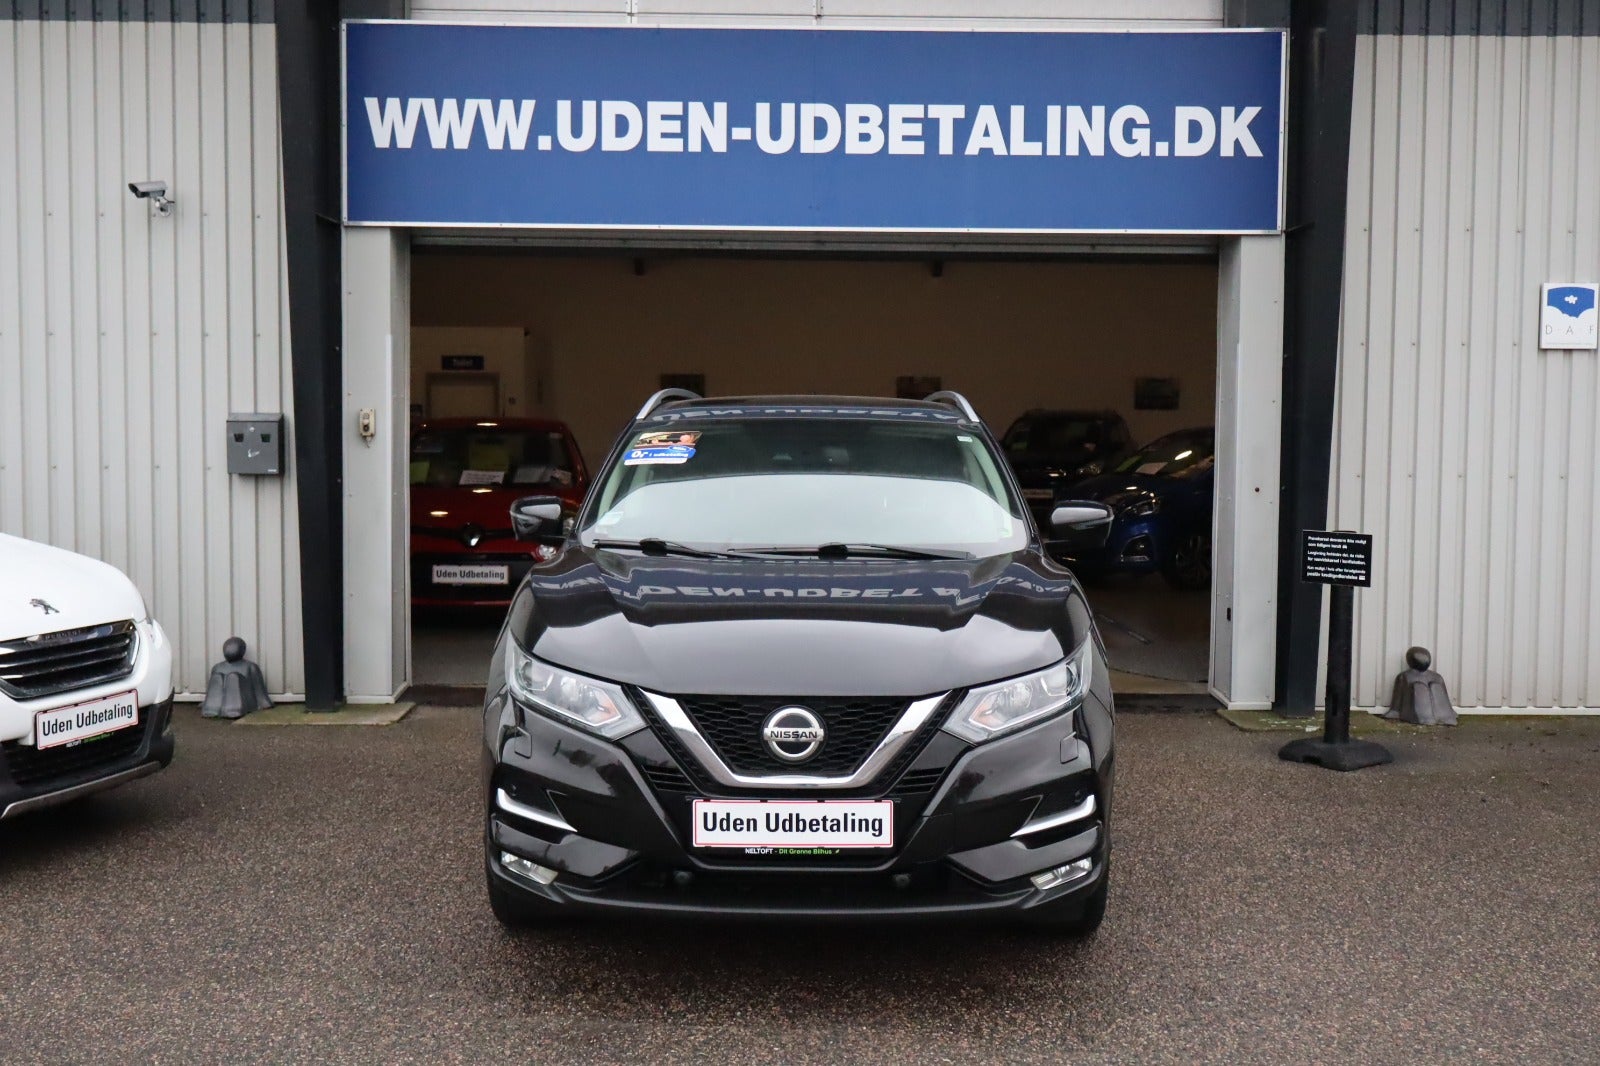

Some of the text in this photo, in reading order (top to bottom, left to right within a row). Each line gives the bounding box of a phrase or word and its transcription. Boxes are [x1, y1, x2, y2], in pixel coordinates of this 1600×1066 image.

[363, 96, 1263, 159] WWW.UDEN-UDBETALING.DK
[436, 570, 504, 580] Uden Udbetaling
[42, 703, 133, 736] Uden Udbetaling
[770, 730, 818, 739] NISSAN
[702, 811, 883, 837] Uden Udbetaling
